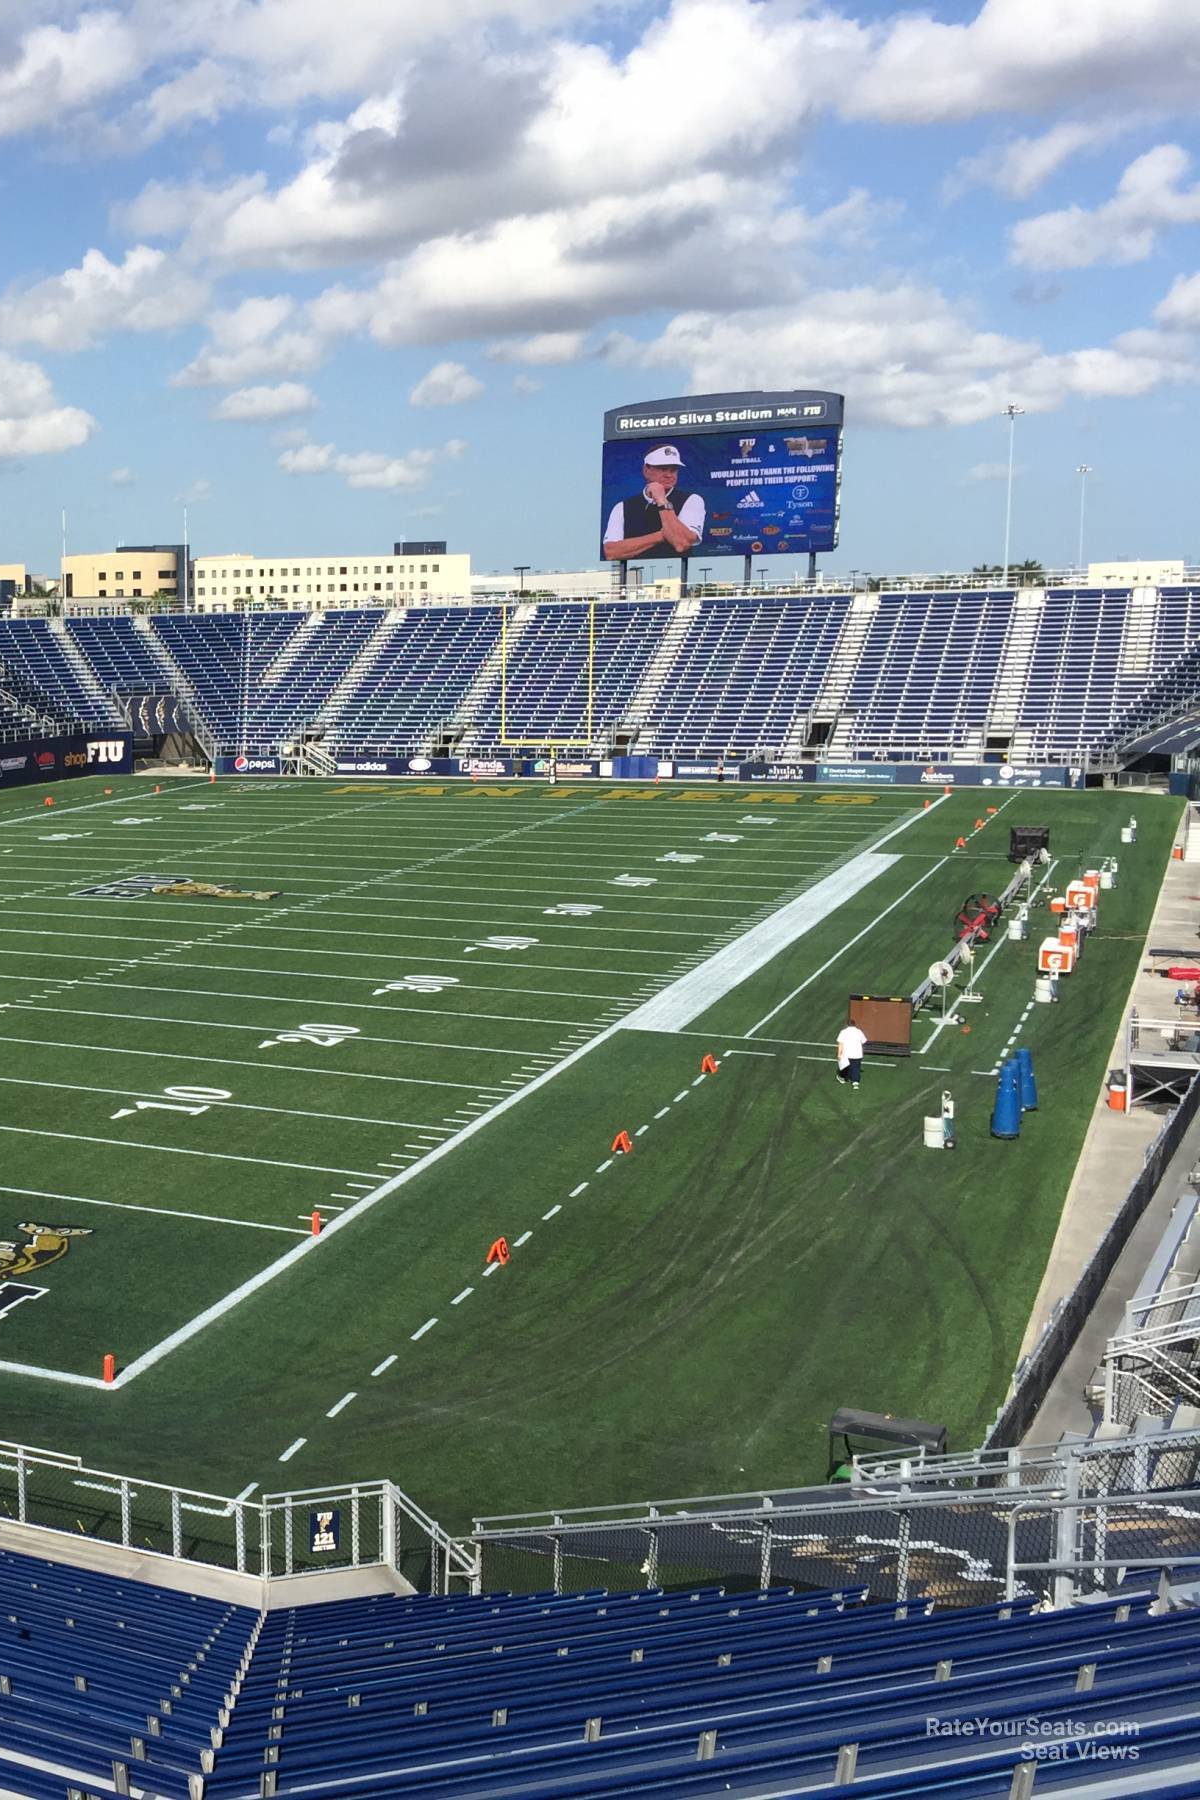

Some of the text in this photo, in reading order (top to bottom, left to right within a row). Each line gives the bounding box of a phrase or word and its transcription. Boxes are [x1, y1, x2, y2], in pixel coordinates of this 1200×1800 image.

[620, 416, 676, 429] Riccardo
[679, 413, 713, 425] Silva
[715, 408, 772, 422] Stadium
[803, 406, 821, 415] FIU
[768, 444, 775, 453] &
[710, 464, 835, 479] WOULD LIKE TO THANK THE FOLLOWING
[726, 478, 749, 487] PEOPLE
[750, 477, 763, 485] FOR
[764, 475, 784, 484] THEIR
[736, 501, 764, 509] adidas
[786, 500, 814, 510] Tyson
[86, 741, 125, 763] FIU
[249, 759, 276, 771] pepsi
[356, 761, 388, 772] adidas
[768, 765, 804, 775] shula's
[322, 785, 883, 806] PANTHERS
[275, 1023, 361, 1048] 20
[135, 1085, 233, 1116] 10
[314, 1532, 334, 1545] 121
